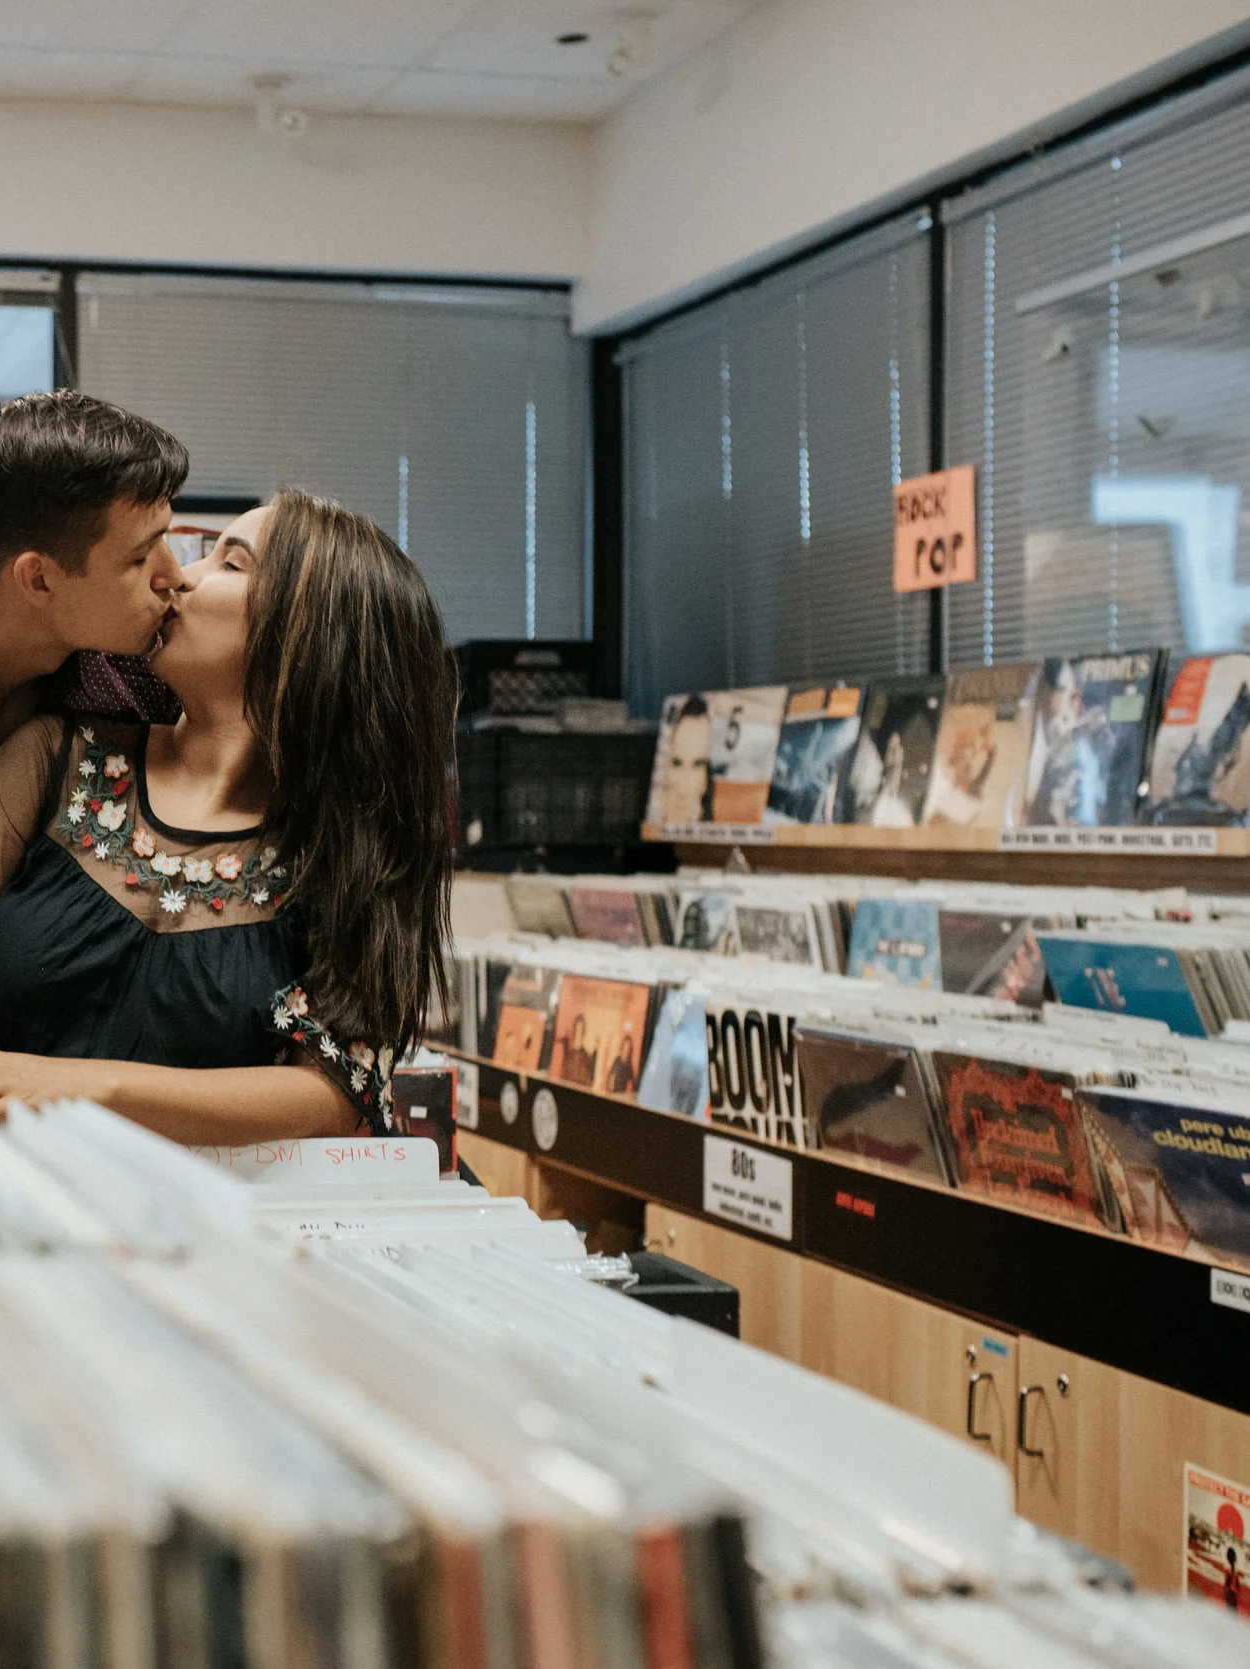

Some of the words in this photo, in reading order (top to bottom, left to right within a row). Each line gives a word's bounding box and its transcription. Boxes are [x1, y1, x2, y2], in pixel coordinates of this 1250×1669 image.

[914, 532, 964, 579] POP
[723, 704, 744, 751] 5
[325, 1142, 407, 1165] SHIRTS
